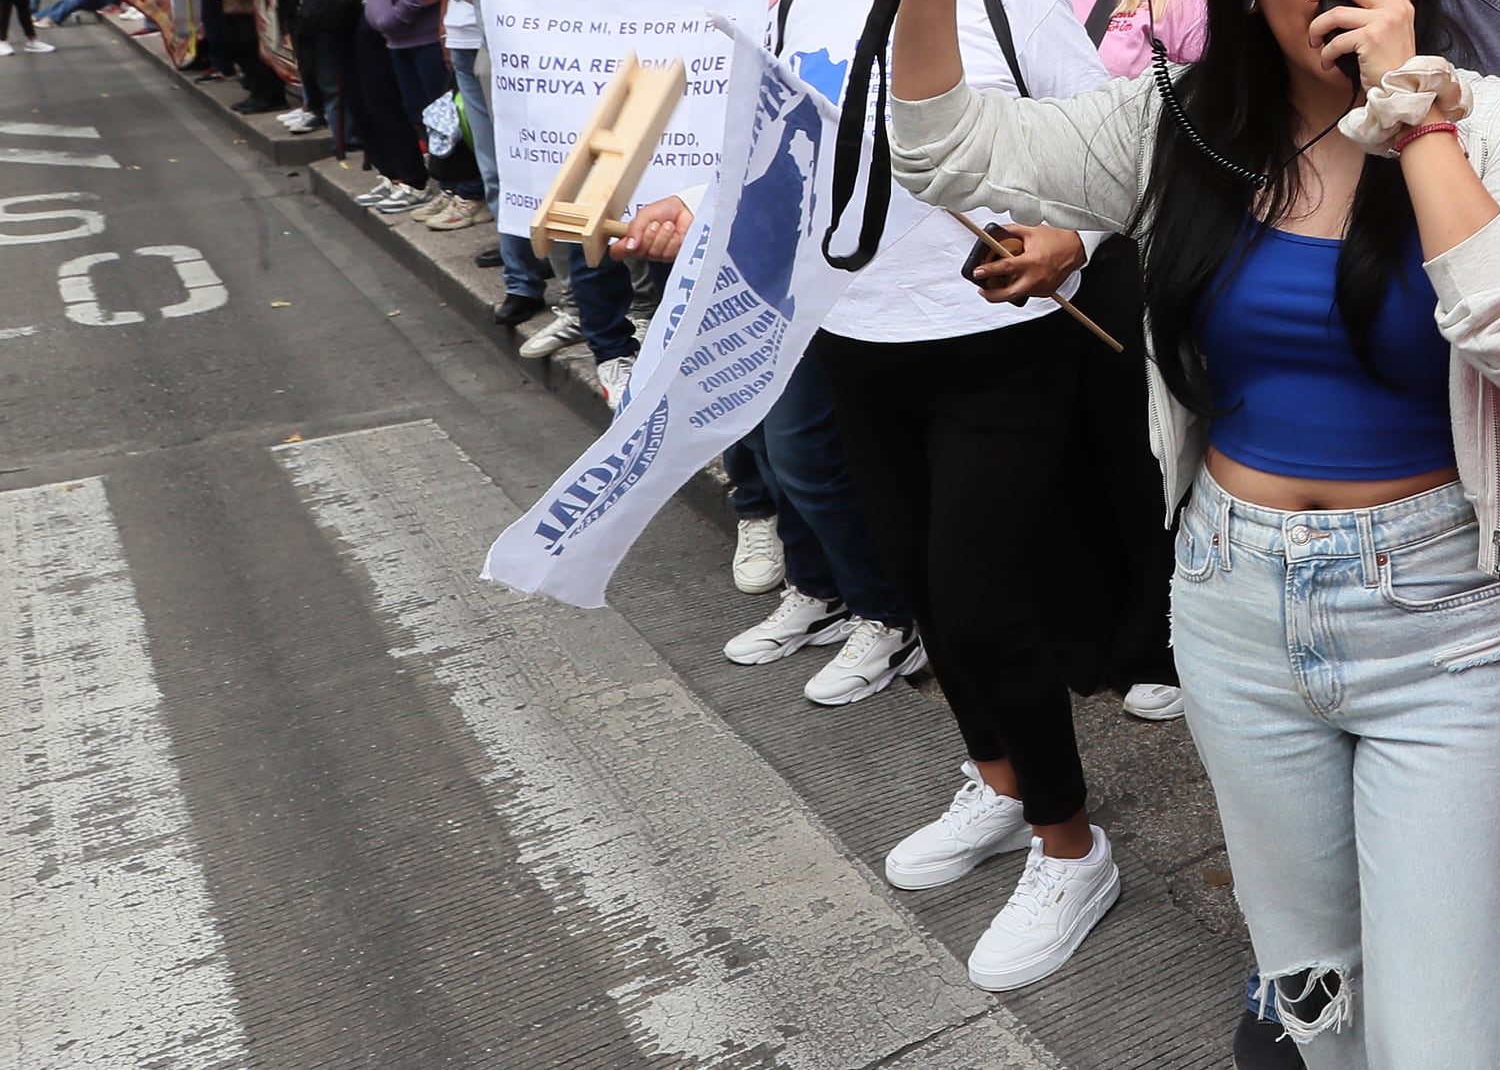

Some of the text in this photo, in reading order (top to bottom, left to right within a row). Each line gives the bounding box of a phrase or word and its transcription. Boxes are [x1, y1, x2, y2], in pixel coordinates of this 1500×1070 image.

[495, 14, 516, 29] NO
[522, 17, 540, 31] ES
[546, 19, 583, 34] POR
[589, 22, 612, 36] MI,
[619, 22, 638, 36] ES
[643, 21, 676, 35] POR
[680, 20, 699, 33] MI
[500, 53, 530, 70] POR
[538, 55, 582, 74] UNA
[690, 55, 727, 76] QUE
[496, 75, 586, 97] CONSTRUYA
[593, 80, 608, 96] Y
[509, 146, 522, 160] LA
